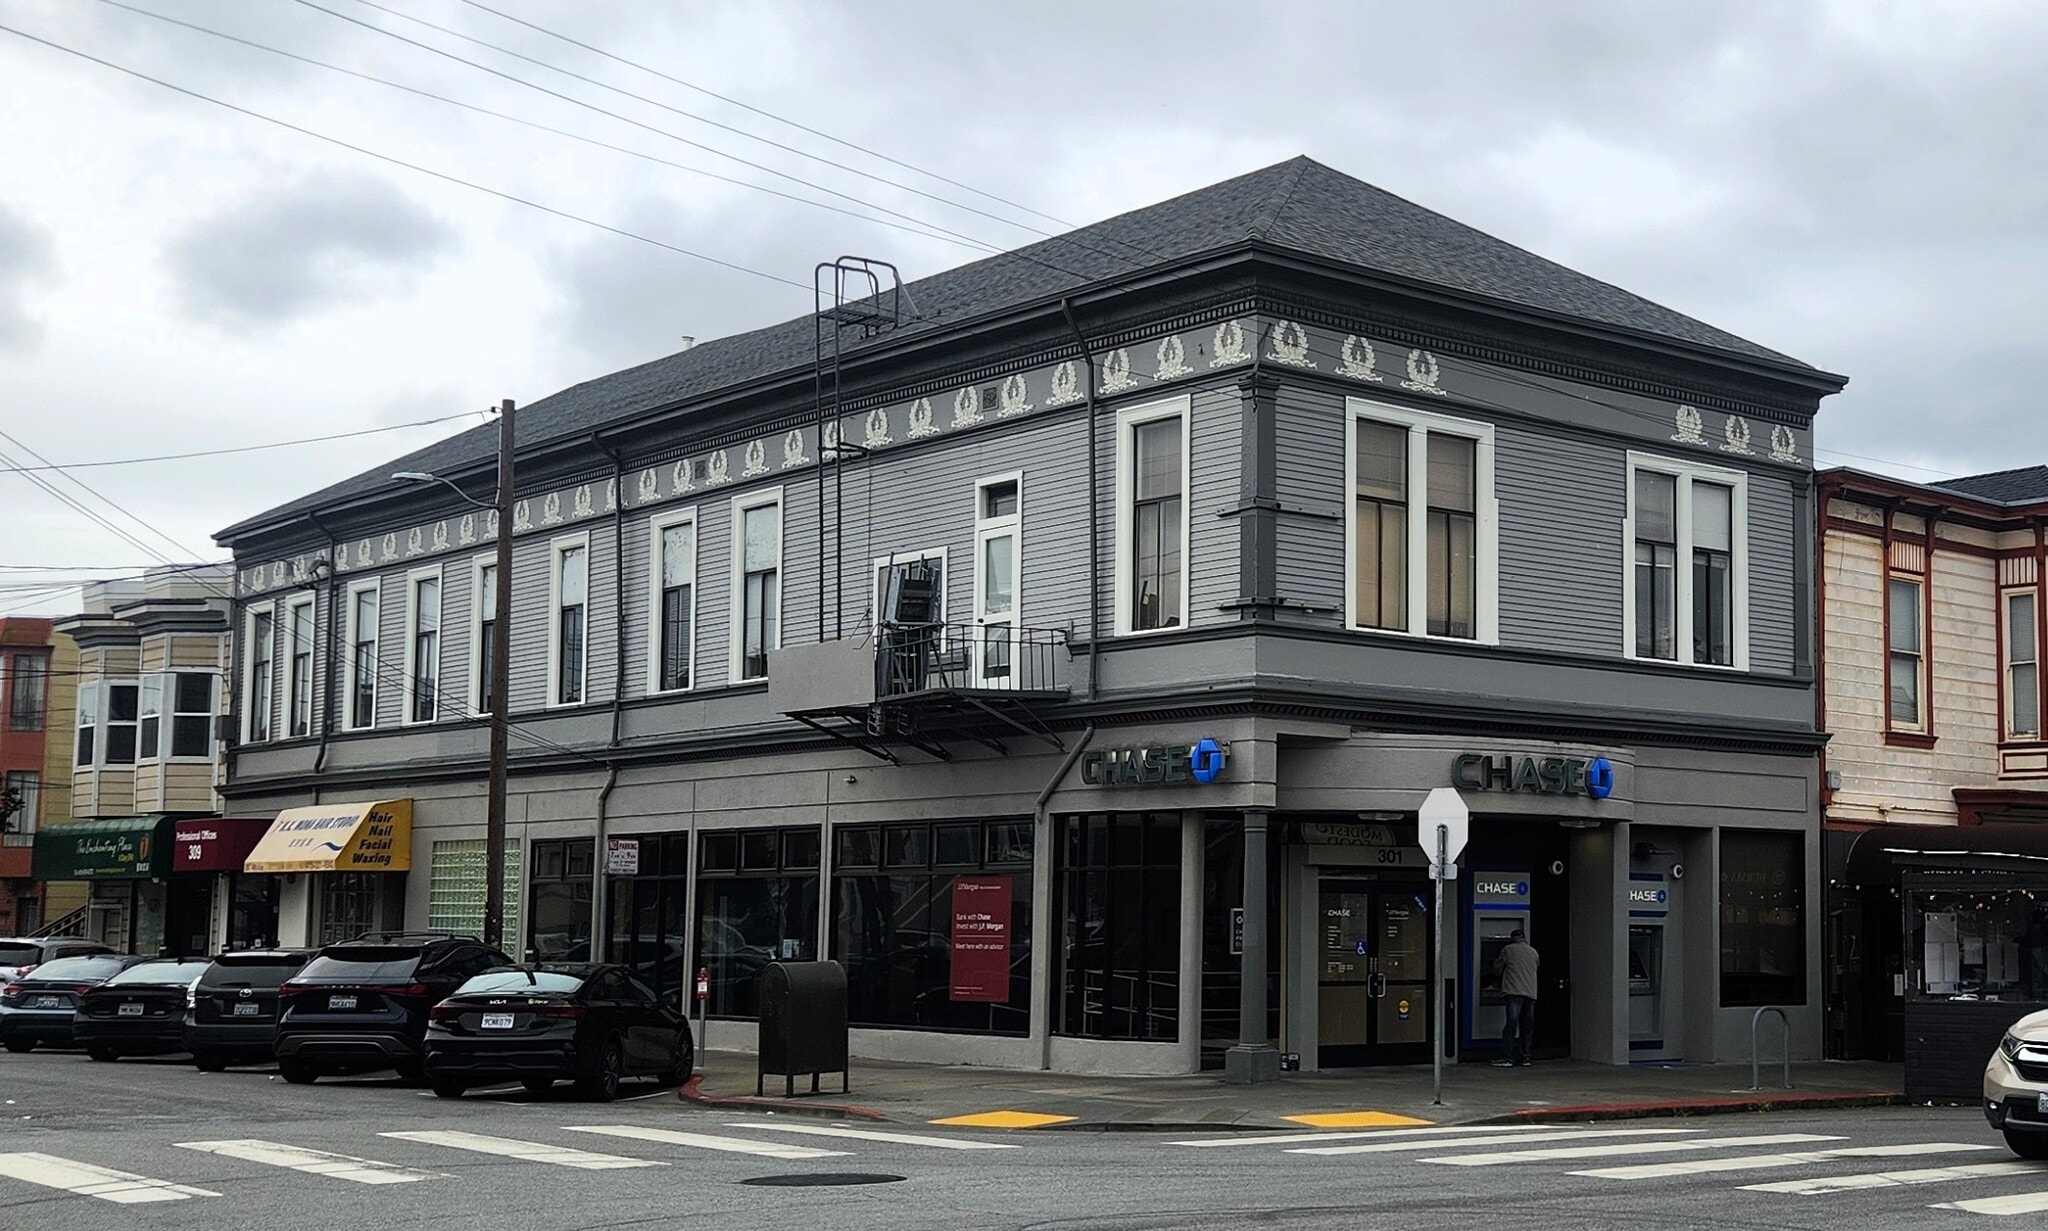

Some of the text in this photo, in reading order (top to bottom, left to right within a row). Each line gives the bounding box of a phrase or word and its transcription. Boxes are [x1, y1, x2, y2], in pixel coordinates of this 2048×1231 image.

[1080, 745, 1187, 785] CHASE
[1452, 753, 1586, 795] CHASE
[368, 811, 393, 824] Hair
[175, 830, 218, 841] Professional Offices
[368, 825, 393, 837] Nail
[359, 838, 393, 850] Facial
[619, 842, 638, 850] PARKING
[188, 844, 202, 860] 309
[1377, 849, 1402, 864] 301
[352, 852, 392, 866] Waxing
[1476, 882, 1517, 894] CHASE
[1629, 890, 1657, 902] HASE
[977, 913, 991, 921] Chase
[1327, 909, 1351, 917] CHASE
[986, 923, 1004, 931] Morgan
